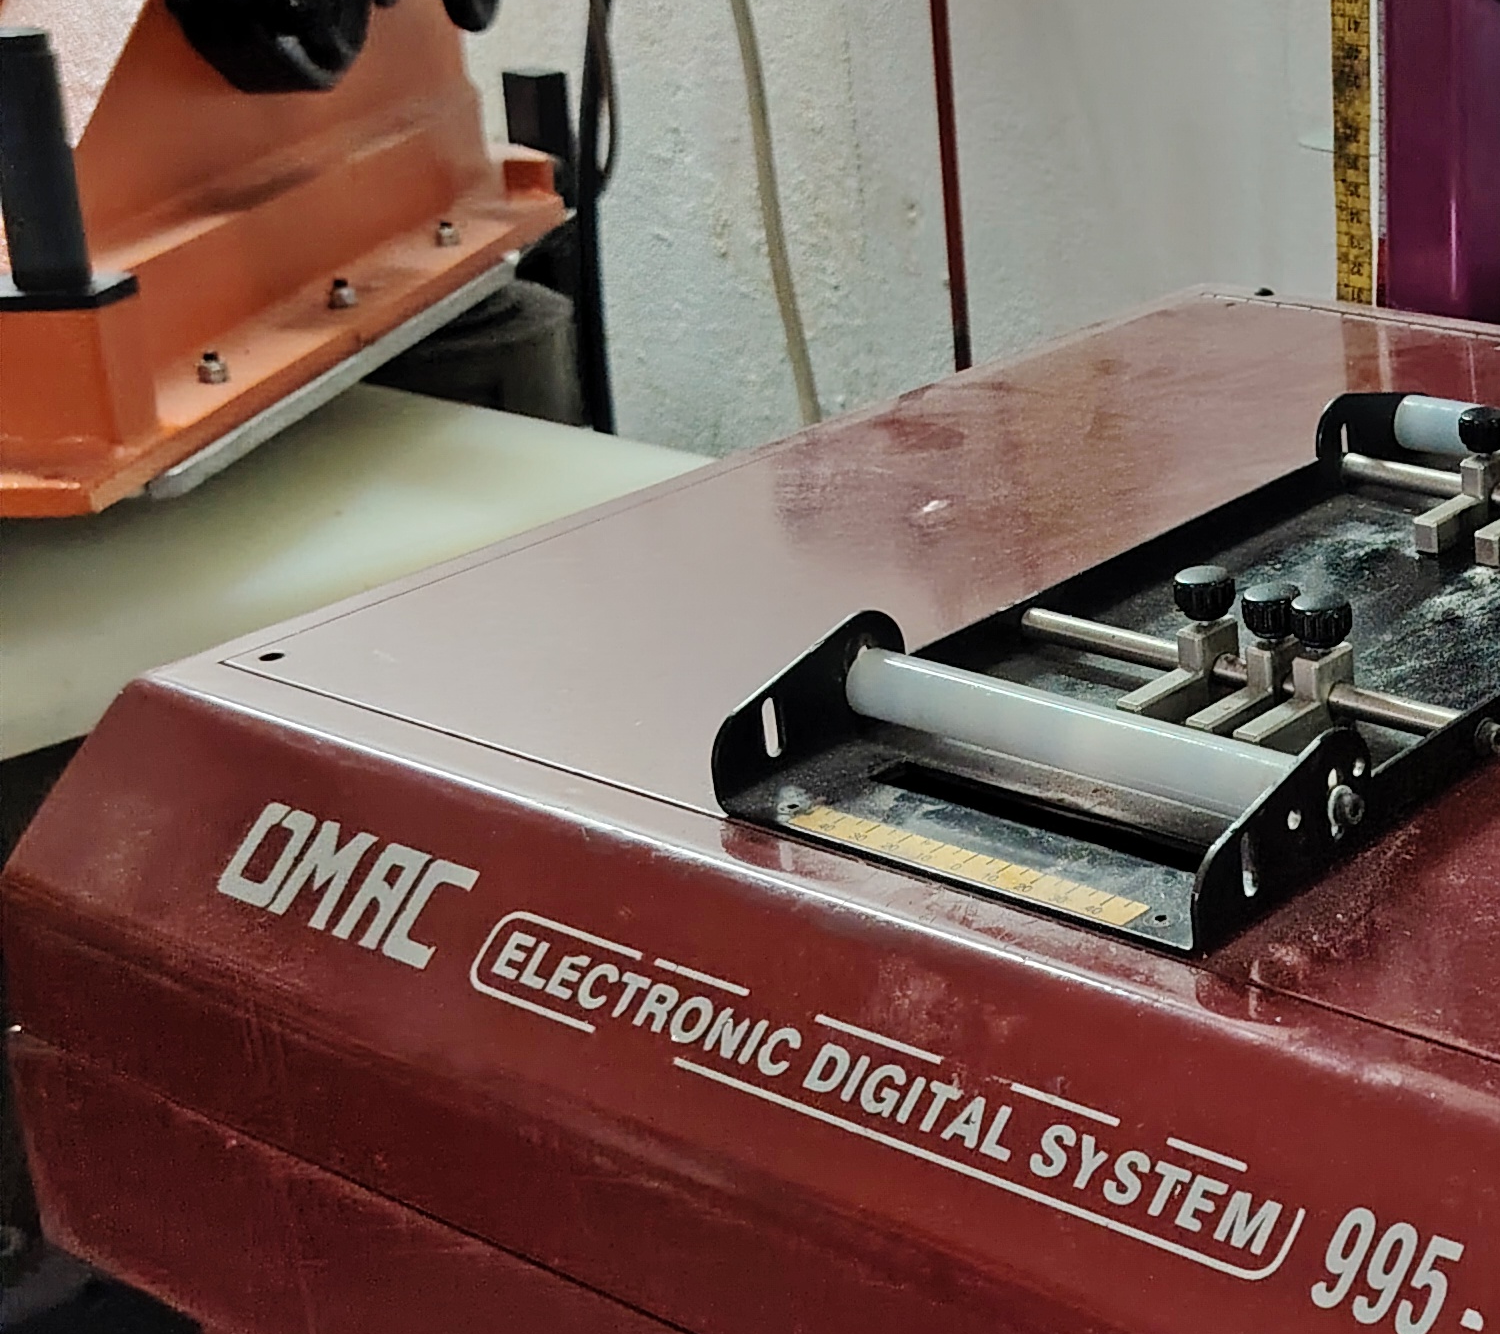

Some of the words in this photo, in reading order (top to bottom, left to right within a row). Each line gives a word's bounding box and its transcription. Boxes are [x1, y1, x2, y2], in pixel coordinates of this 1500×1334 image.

[215, 801, 480, 969] OMAC
[1013, 882, 1033, 893] 20
[1084, 904, 1103, 915] 40
[490, 930, 802, 1078] ELECTRONIC
[802, 1042, 1012, 1162] DIGITAL
[1028, 1123, 1283, 1256] SYSTEM
